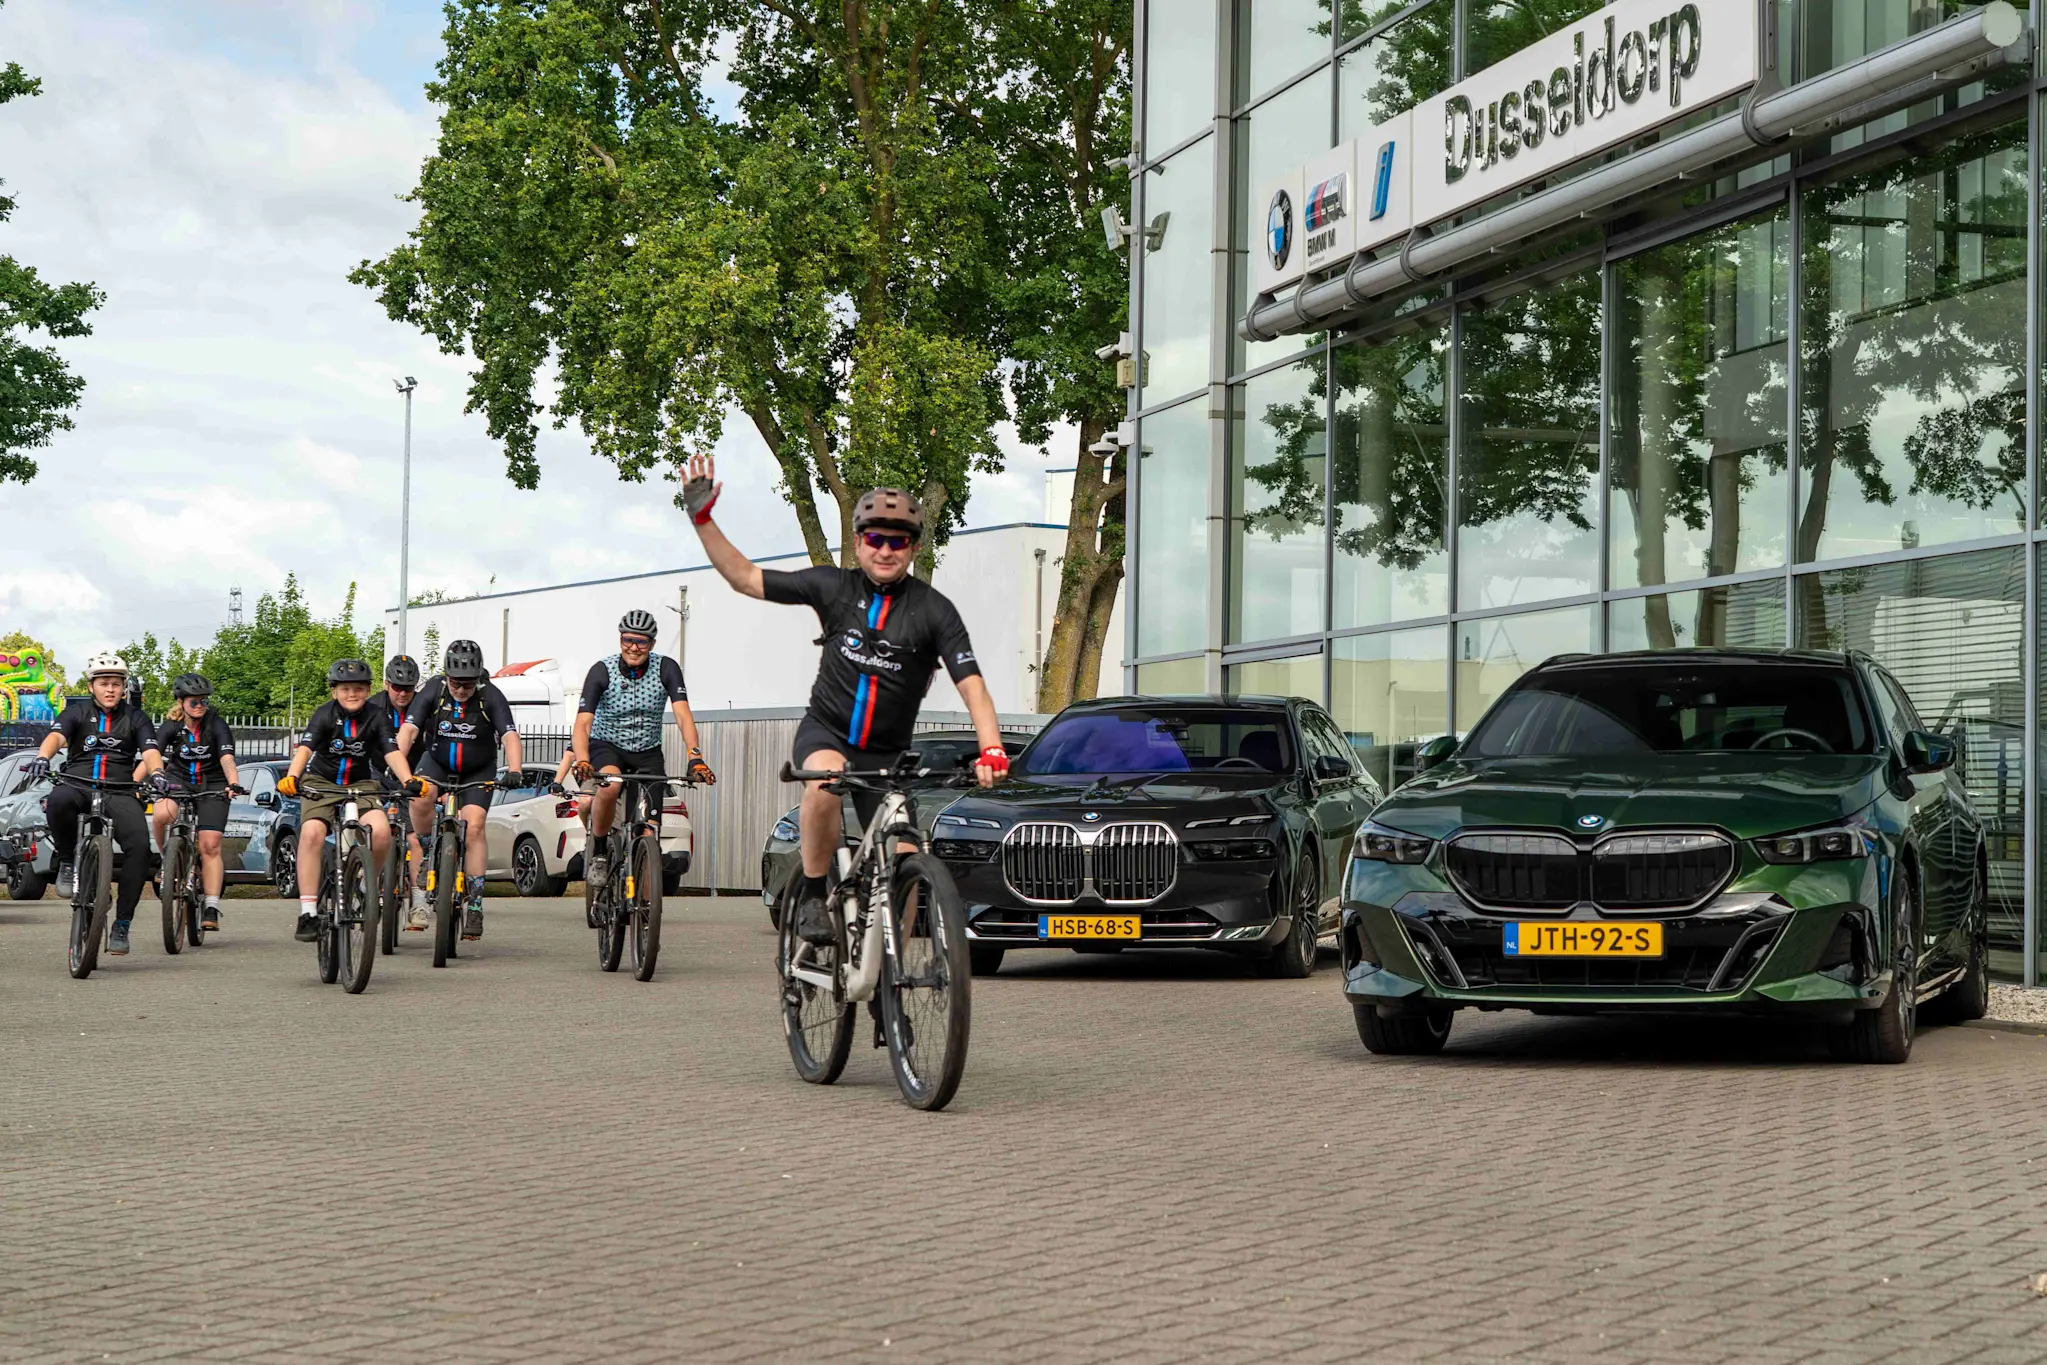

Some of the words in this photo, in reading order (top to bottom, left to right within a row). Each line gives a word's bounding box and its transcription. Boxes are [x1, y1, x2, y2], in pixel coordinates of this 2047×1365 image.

[1445, 3, 1701, 185] Dusseldorp
[1307, 232, 1327, 257] BMW
[1328, 228, 1336, 248] M
[1053, 919, 1133, 935] HSB-68-S
[1530, 927, 1650, 951] JTH-92-S
